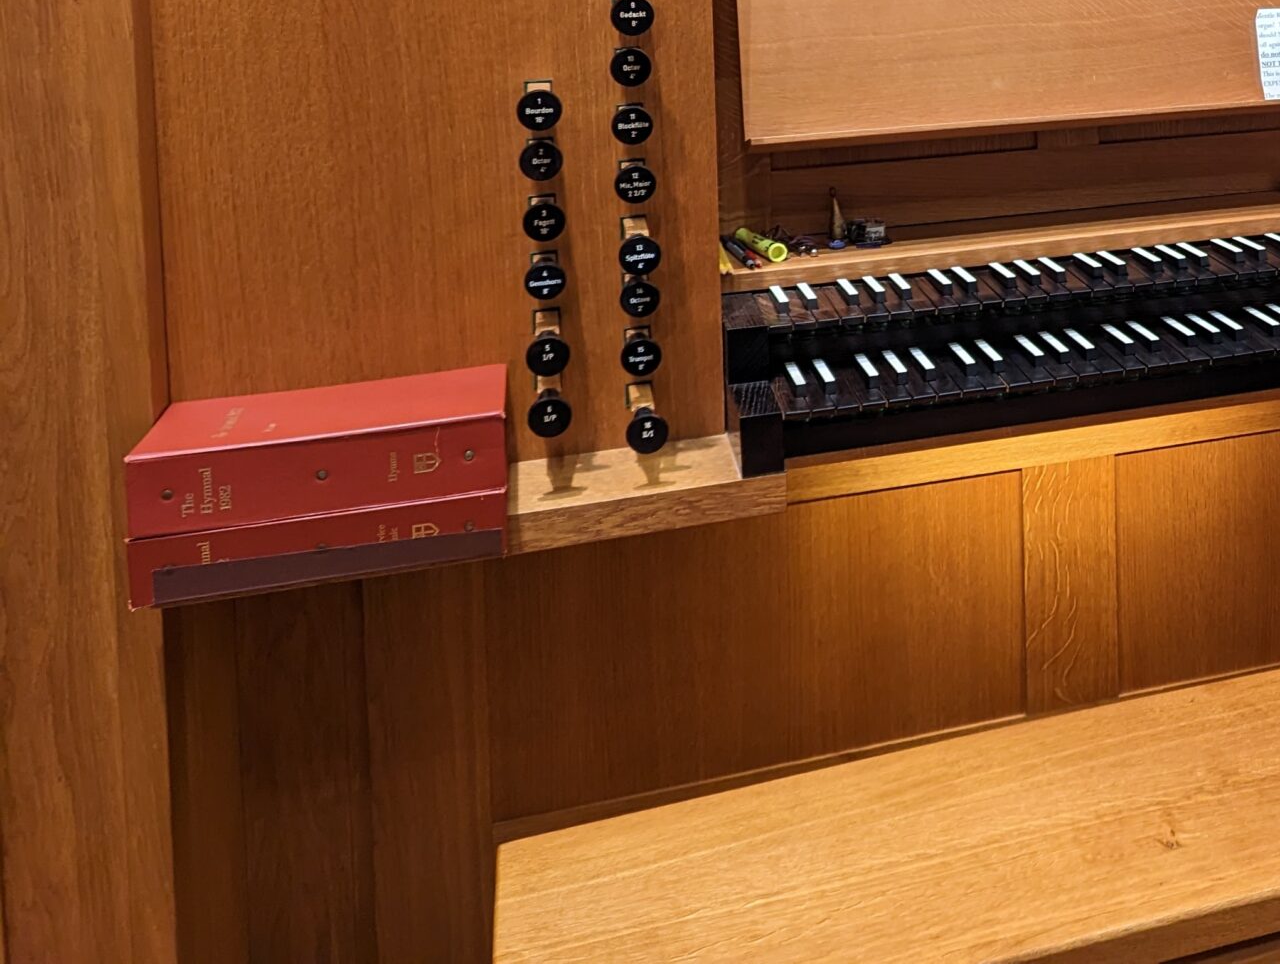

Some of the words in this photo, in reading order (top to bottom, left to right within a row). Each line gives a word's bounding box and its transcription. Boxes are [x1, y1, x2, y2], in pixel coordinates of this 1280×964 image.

[525, 107, 554, 115] Bourdon
[529, 278, 562, 287] Gemshorn
[542, 353, 554, 361] I/P
[544, 414, 557, 422] II/P
[388, 452, 400, 482] Hymns
[198, 468, 216, 514] Hymnal
[219, 485, 231, 510] 1982
[181, 492, 194, 517] The
